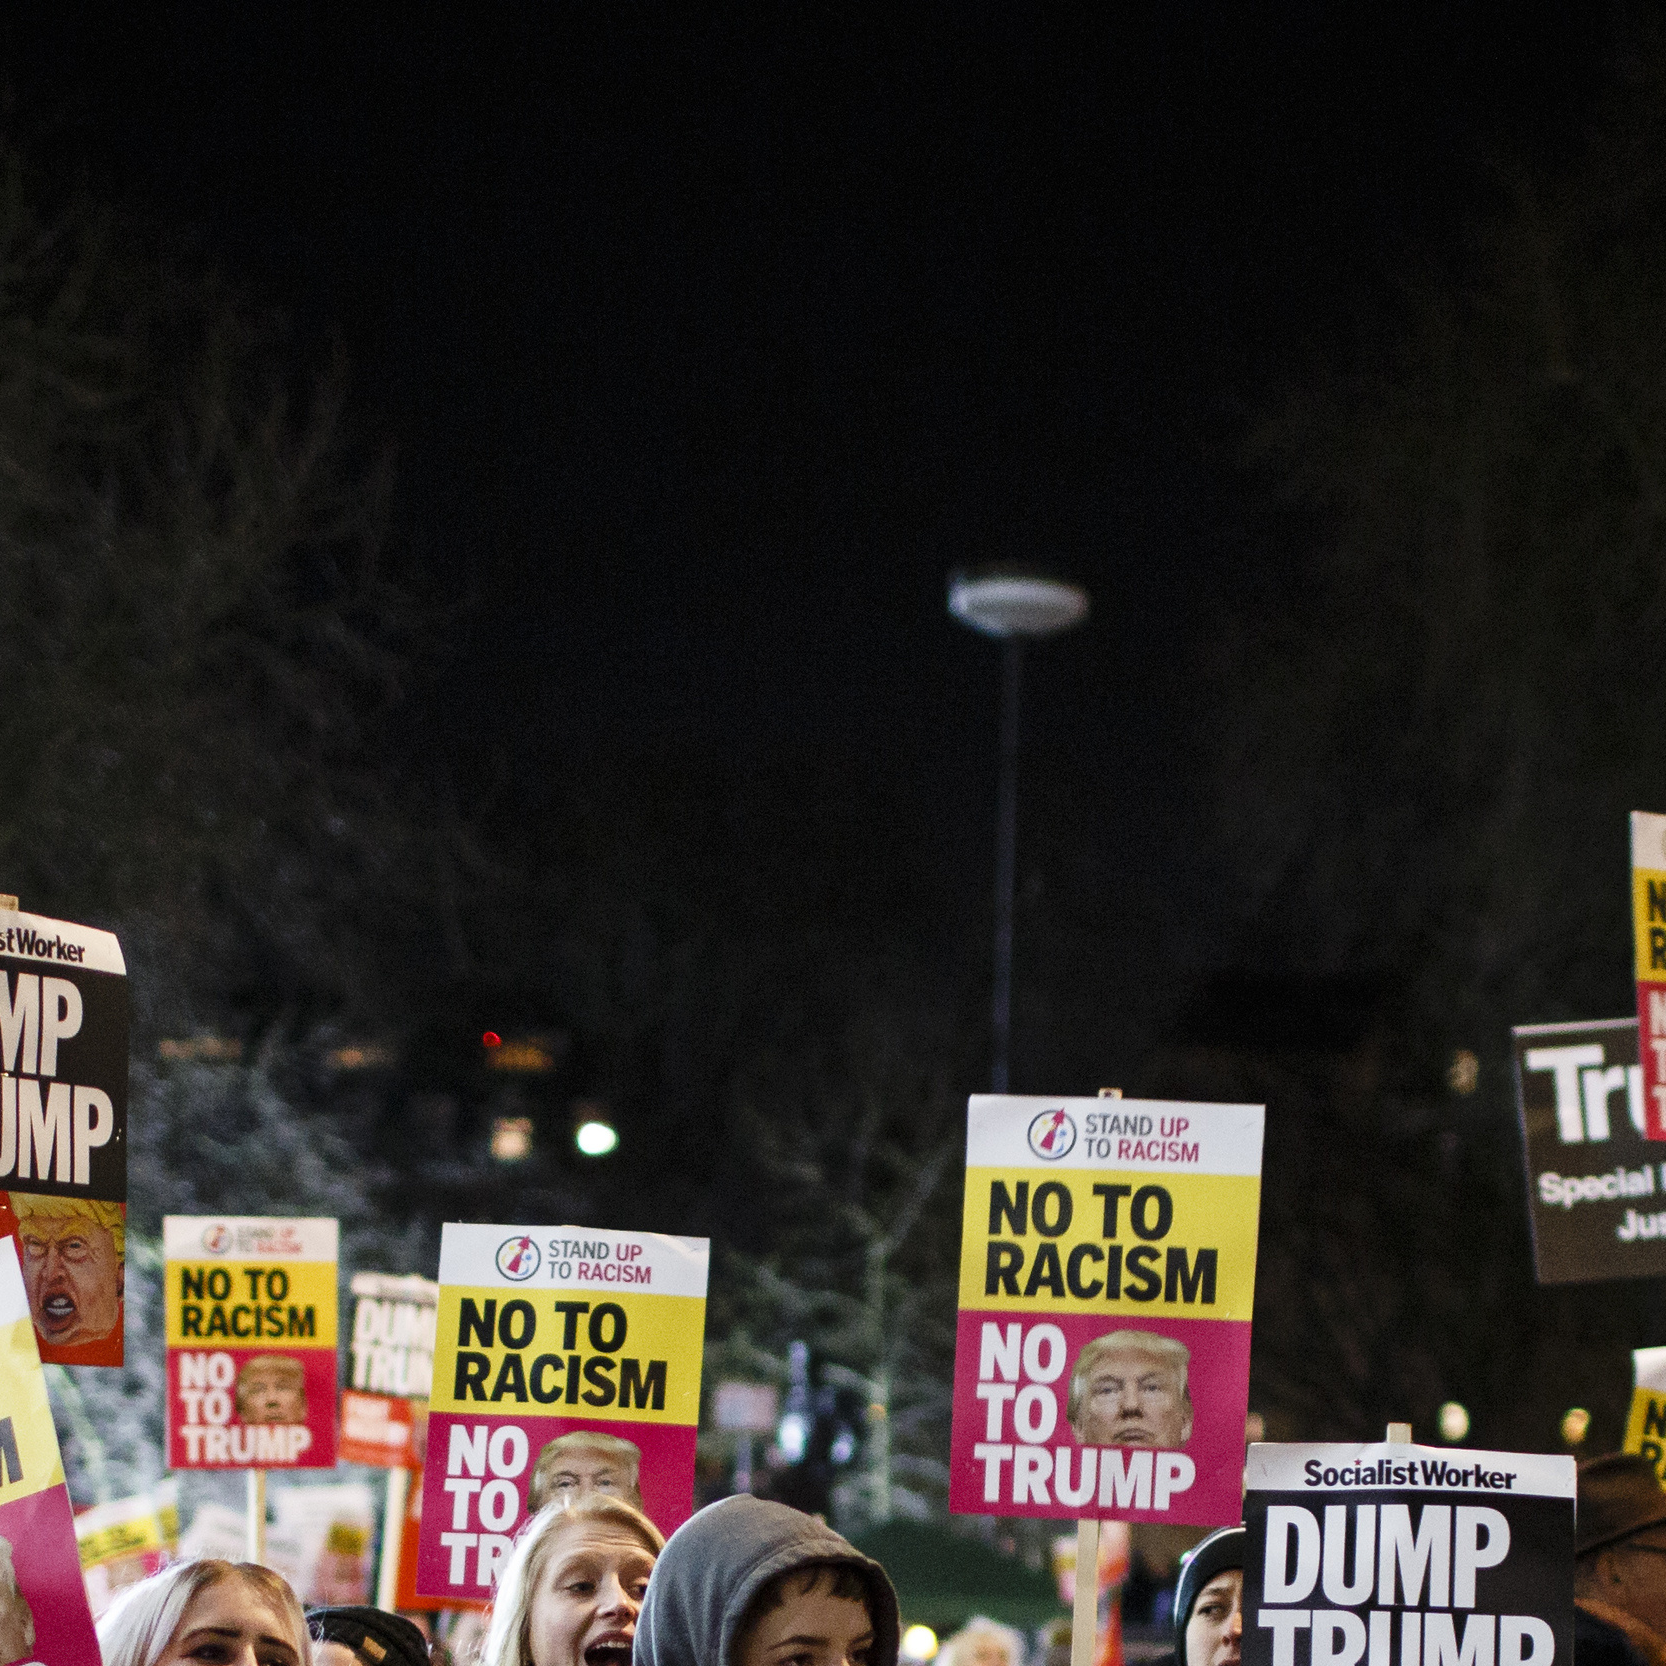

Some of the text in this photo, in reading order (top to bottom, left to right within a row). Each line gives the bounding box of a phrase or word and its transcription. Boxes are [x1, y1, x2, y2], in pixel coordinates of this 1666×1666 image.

[1085, 1114, 1190, 1138] STAND UP
[1085, 1138, 1200, 1163] TO RACISM
[988, 1180, 1173, 1241] NO TO
[1538, 1167, 1655, 1208] Special
[549, 1240, 642, 1261] STAND UP
[549, 1261, 651, 1284] TO RACISM
[984, 1241, 1218, 1304] RACISM
[180, 1267, 289, 1301] NO TO
[181, 1304, 317, 1338] RACISM
[457, 1298, 628, 1353] NO TO
[179, 1352, 236, 1388] NO
[979, 1322, 1067, 1385] NO
[453, 1352, 667, 1411] RACISM
[182, 1389, 232, 1425] TO
[976, 1382, 1057, 1445] TO
[182, 1425, 312, 1463] TRUMP
[447, 1424, 529, 1479] NO
[974, 1443, 1195, 1511] TRUMP
[444, 1478, 518, 1531] TO
[1263, 1504, 1511, 1609] DUMP
